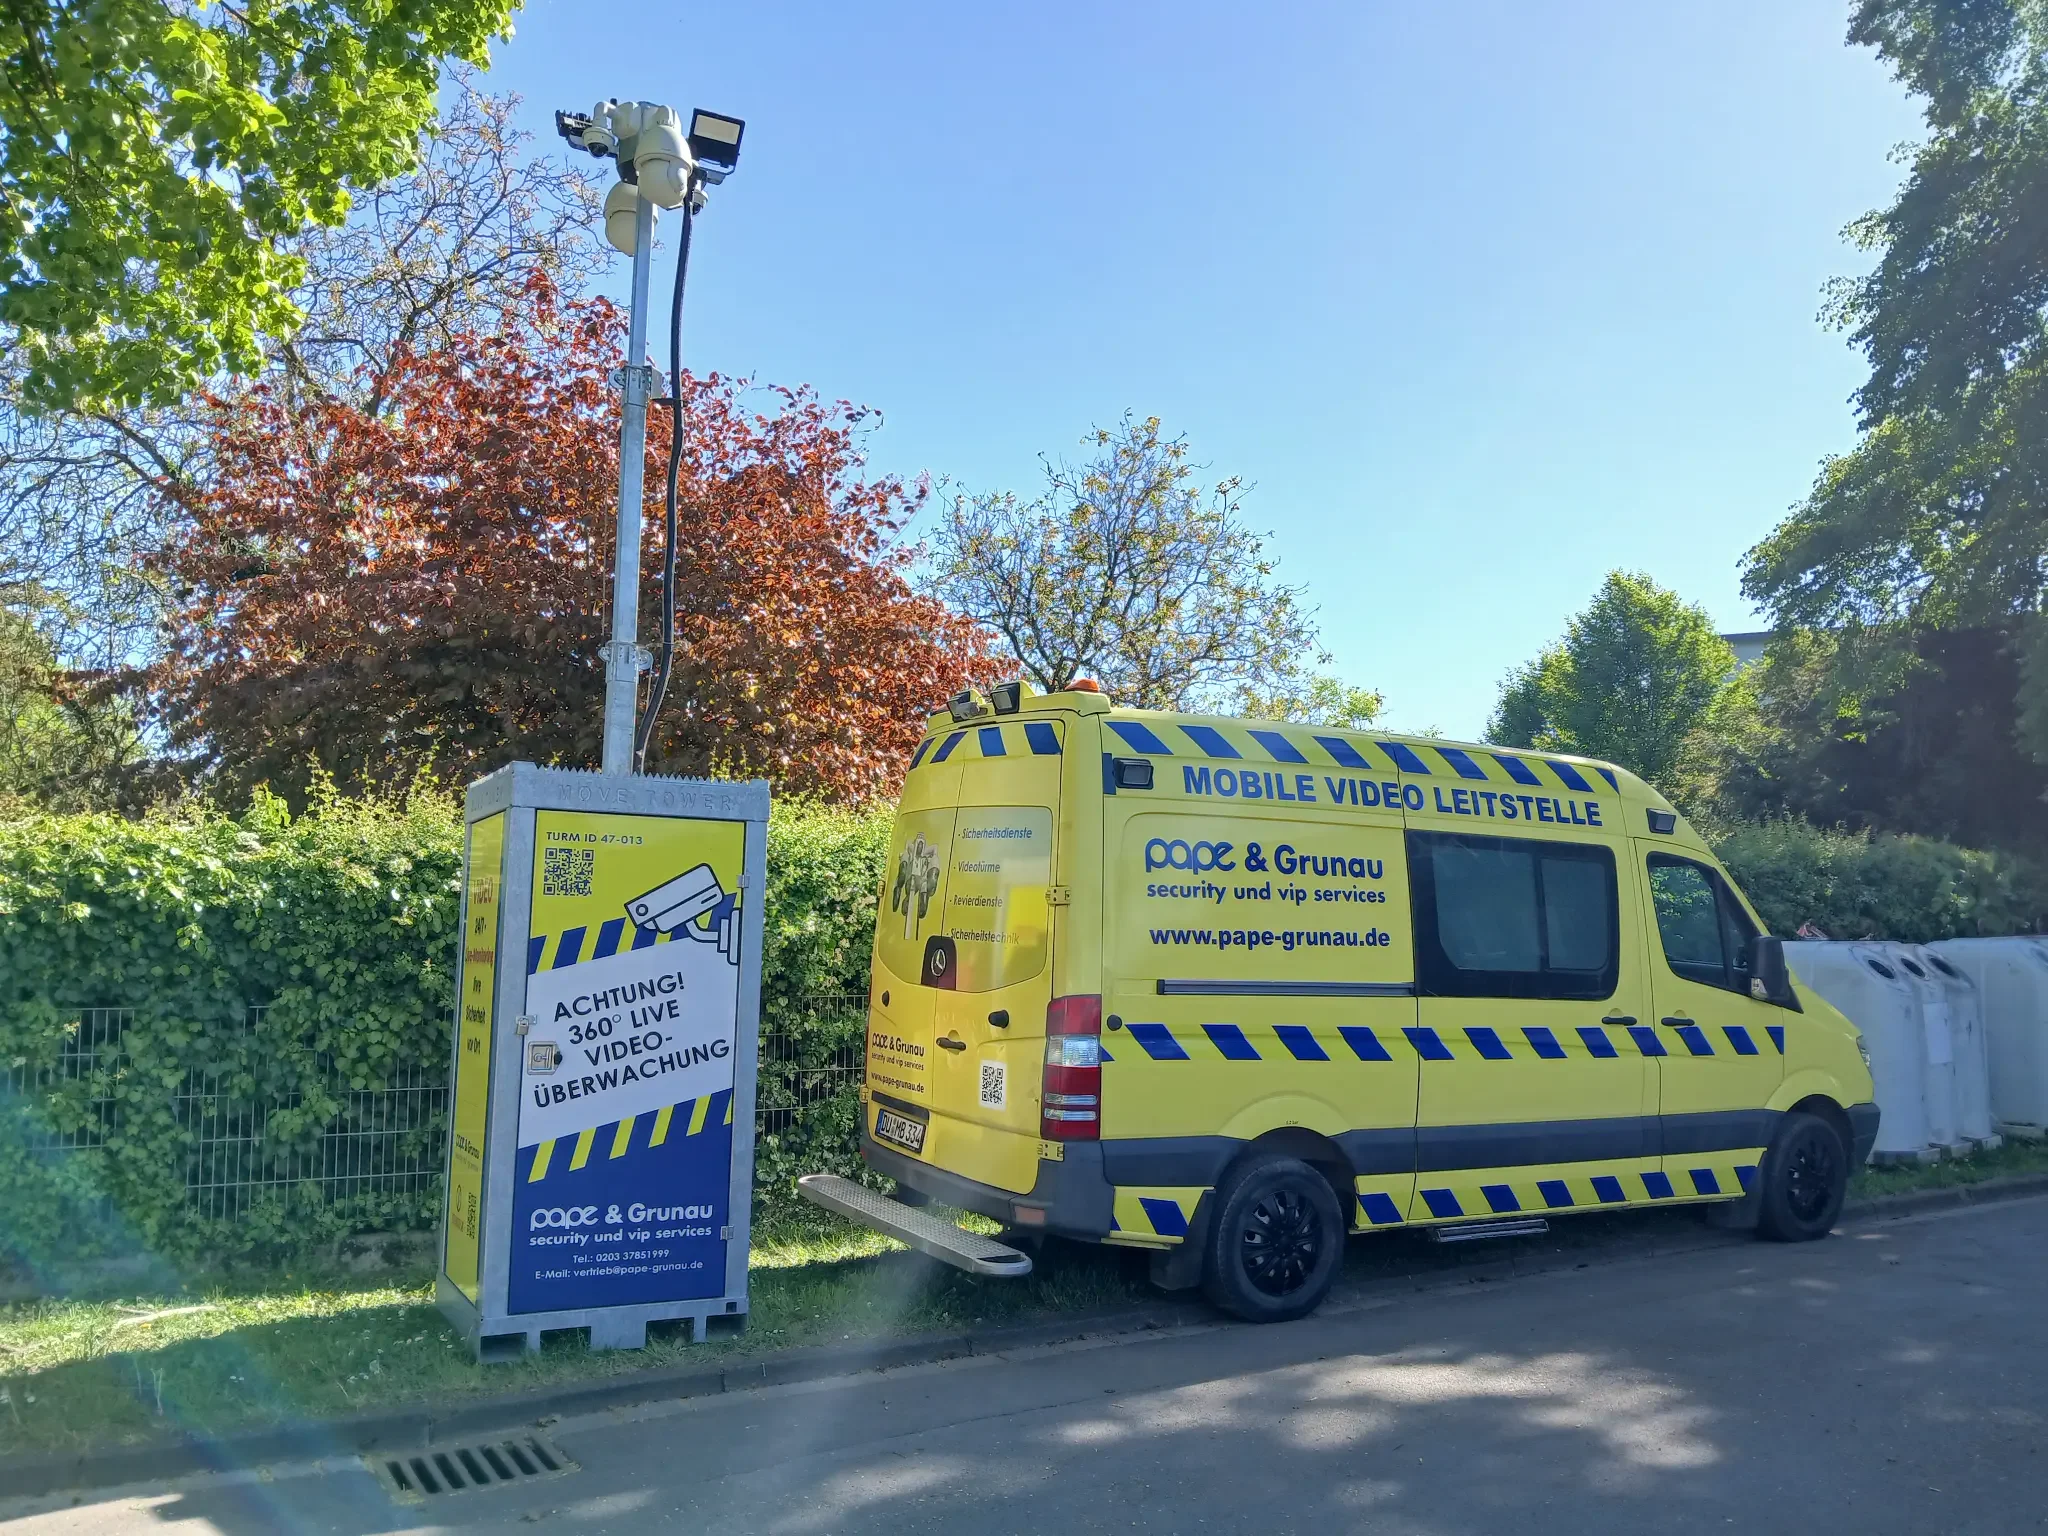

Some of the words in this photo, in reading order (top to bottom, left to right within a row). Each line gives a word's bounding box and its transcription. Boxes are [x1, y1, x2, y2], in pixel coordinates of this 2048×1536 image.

[559, 784, 629, 804] MOVE
[1182, 765, 1316, 802] MOBILE
[1324, 776, 1424, 811] VIDEO
[1433, 786, 1603, 827] LEITSTELLE
[546, 831, 580, 842] TURM
[584, 833, 597, 843] ID
[600, 834, 643, 845] 47-013
[961, 827, 1033, 840] Sicherheitsdienste
[958, 860, 1001, 873] Videotürme
[1144, 838, 1236, 875] pape
[1245, 842, 1269, 872] &
[1274, 844, 1383, 879] Grunau
[953, 894, 1003, 908] Revierdienste
[1147, 880, 1226, 905] security
[1234, 881, 1271, 900] und
[1277, 882, 1307, 906] vip
[1314, 885, 1386, 903] services
[950, 928, 1020, 945] Sicherheitstechnik
[1149, 928, 1390, 950] www.pape-grunau.de
[554, 971, 685, 1022] ACHTUNG!
[568, 1013, 622, 1045] 360°
[630, 1000, 680, 1028] LIVE
[584, 1031, 673, 1066] VIDEO-
[872, 1032, 888, 1050] pape
[889, 1036, 895, 1051] &
[895, 1037, 925, 1057] Grunau
[871, 1052, 885, 1065] security
[886, 1055, 895, 1065] und
[904, 1060, 925, 1071] services
[534, 1038, 730, 1108] ÜBERWACHUNG
[871, 1071, 925, 1093] www.pape-grunau.de
[881, 1114, 893, 1133] DU
[905, 1124, 921, 1146] 334
[529, 1205, 599, 1232] pape
[604, 1204, 624, 1224] &
[627, 1202, 713, 1223] Grunau
[529, 1231, 589, 1247] security
[594, 1228, 623, 1243] und
[628, 1227, 651, 1243] vip
[655, 1225, 712, 1239] services
[572, 1253, 593, 1263] Tel.:
[595, 1252, 620, 1262] 0203
[622, 1249, 670, 1261] 37851999
[535, 1268, 571, 1280] E-Mail:
[573, 1260, 704, 1277] vertrieb@pape-grunau.de
